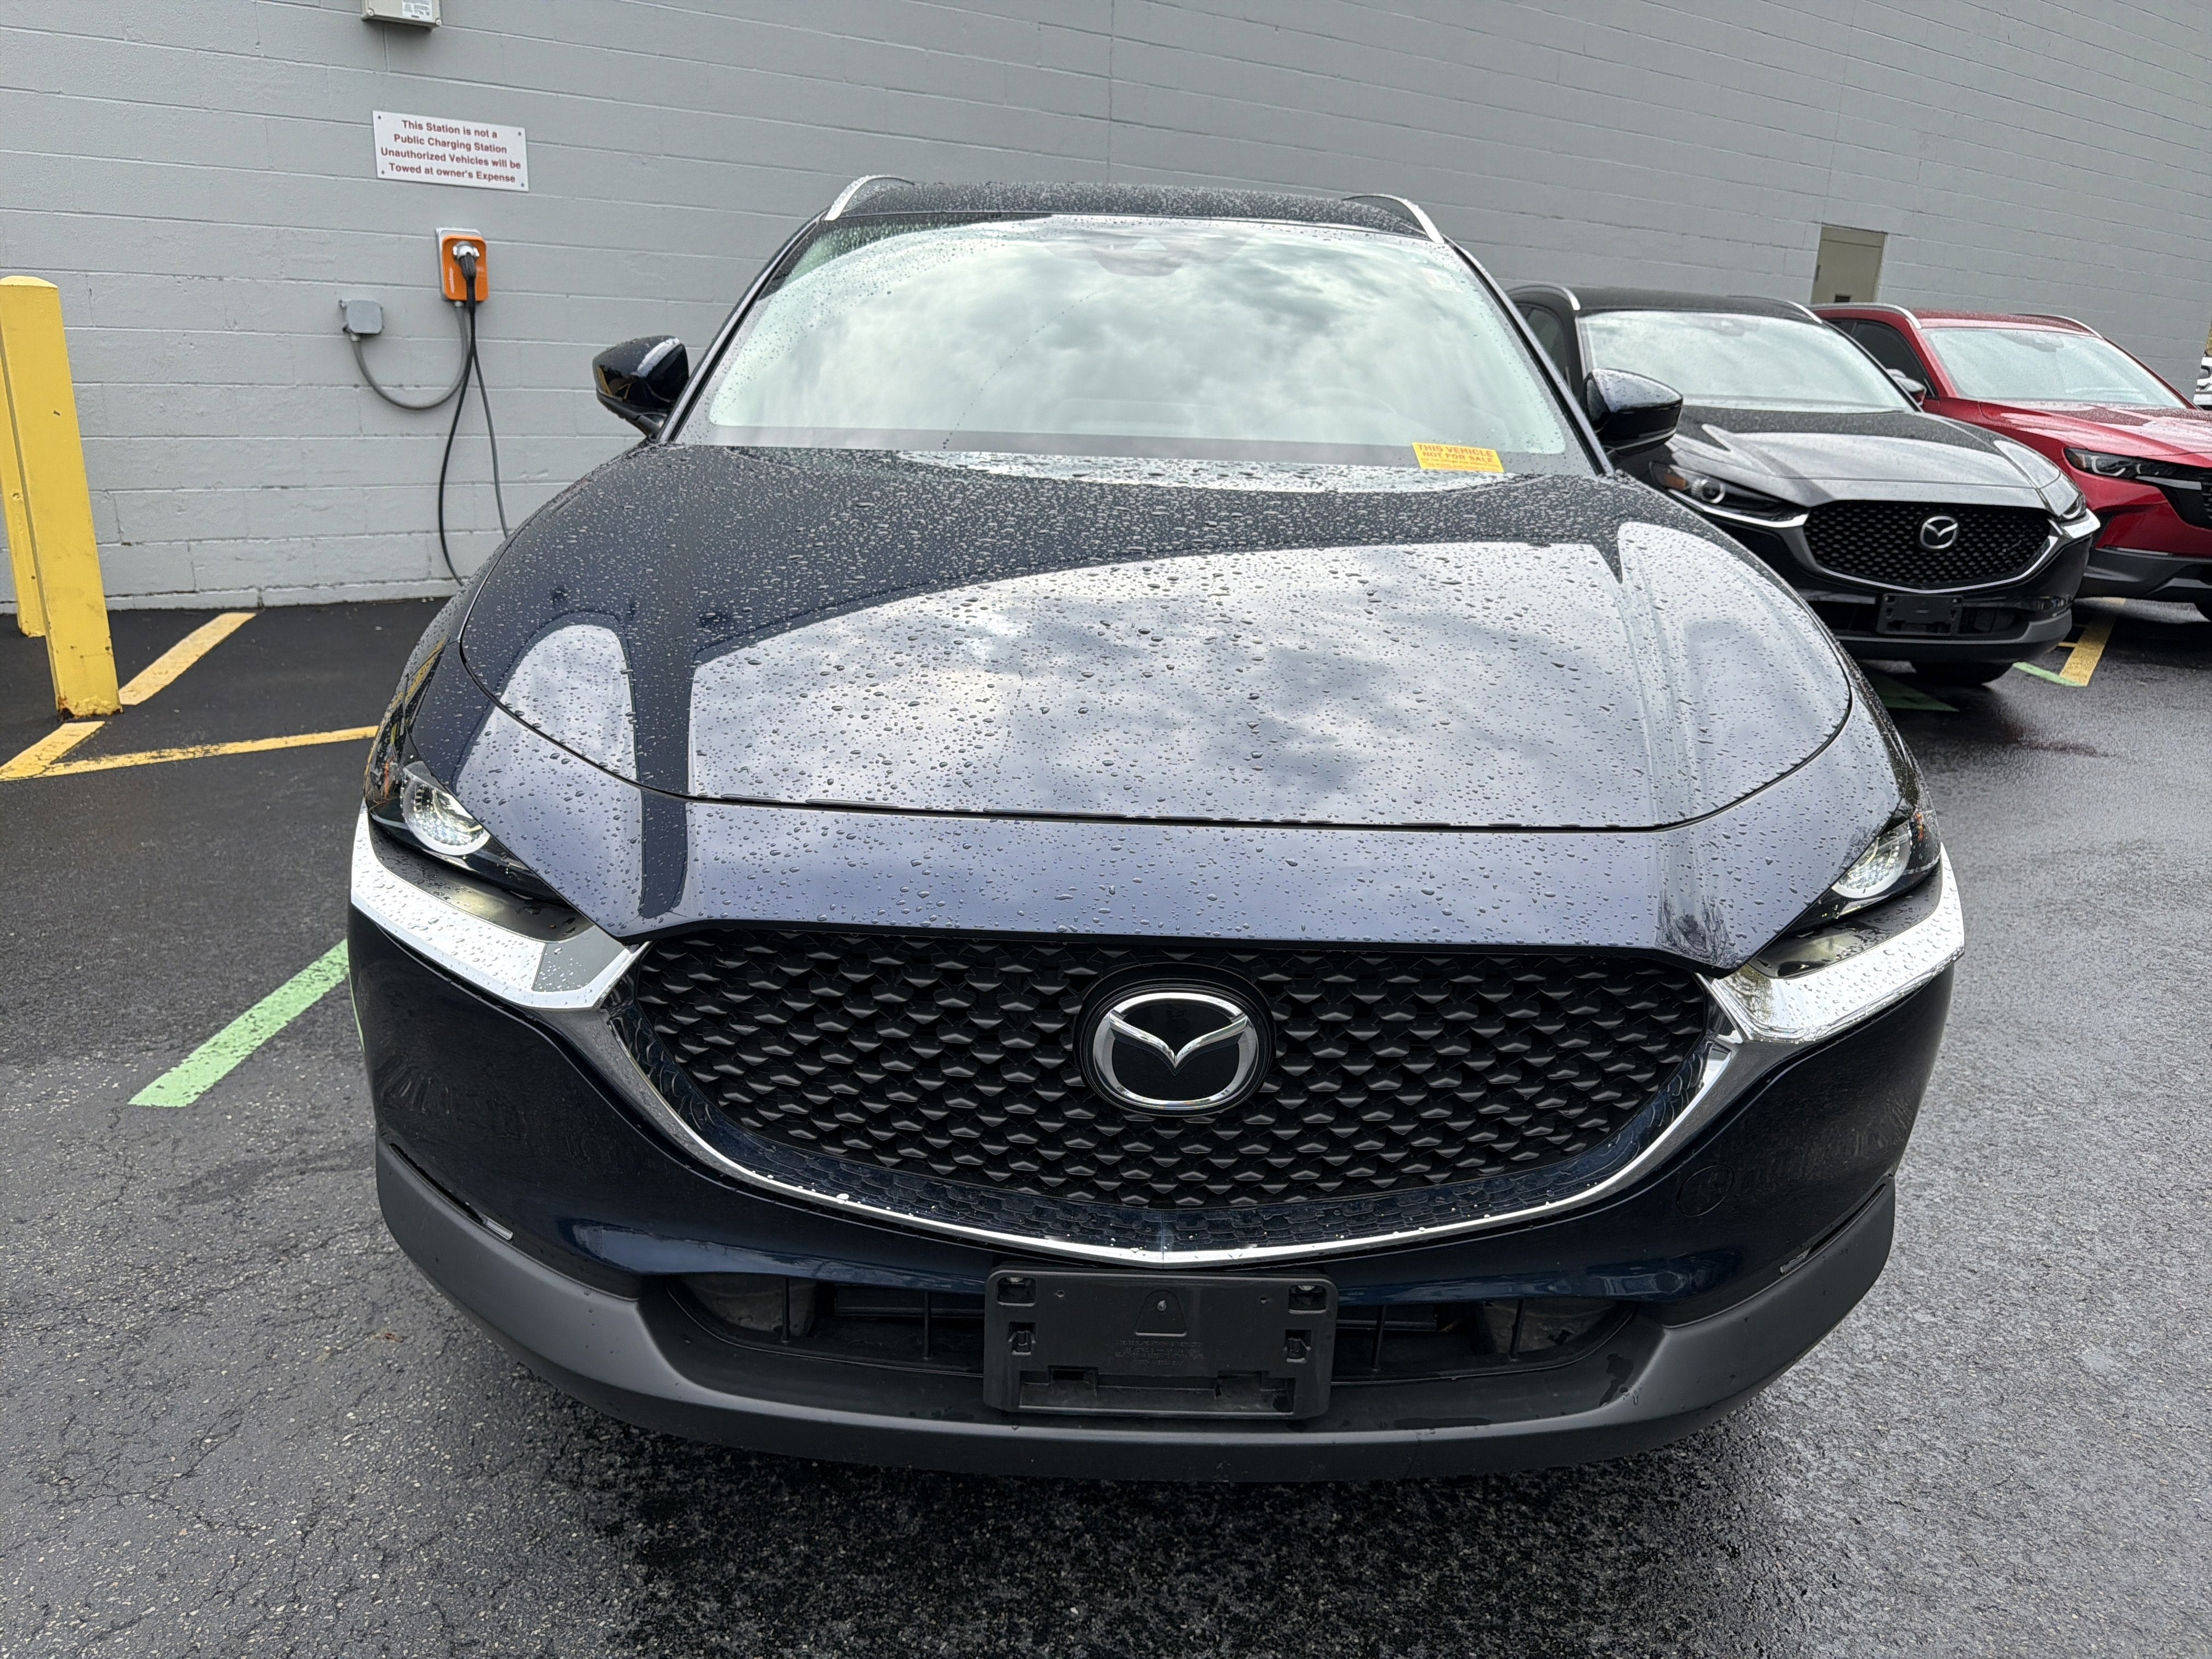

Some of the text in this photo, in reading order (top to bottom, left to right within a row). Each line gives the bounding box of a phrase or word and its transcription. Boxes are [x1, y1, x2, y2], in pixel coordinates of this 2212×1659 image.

[402, 120, 424, 131] This
[426, 122, 460, 134] Station
[463, 126, 471, 136] is
[474, 129, 489, 138] not
[394, 134, 507, 154] Public Charging Station
[380, 146, 521, 169] Unauthorized Vehicles will be
[389, 162, 515, 183] Towed at owner's Expense
[1446, 446, 1493, 457] VEHICLE
